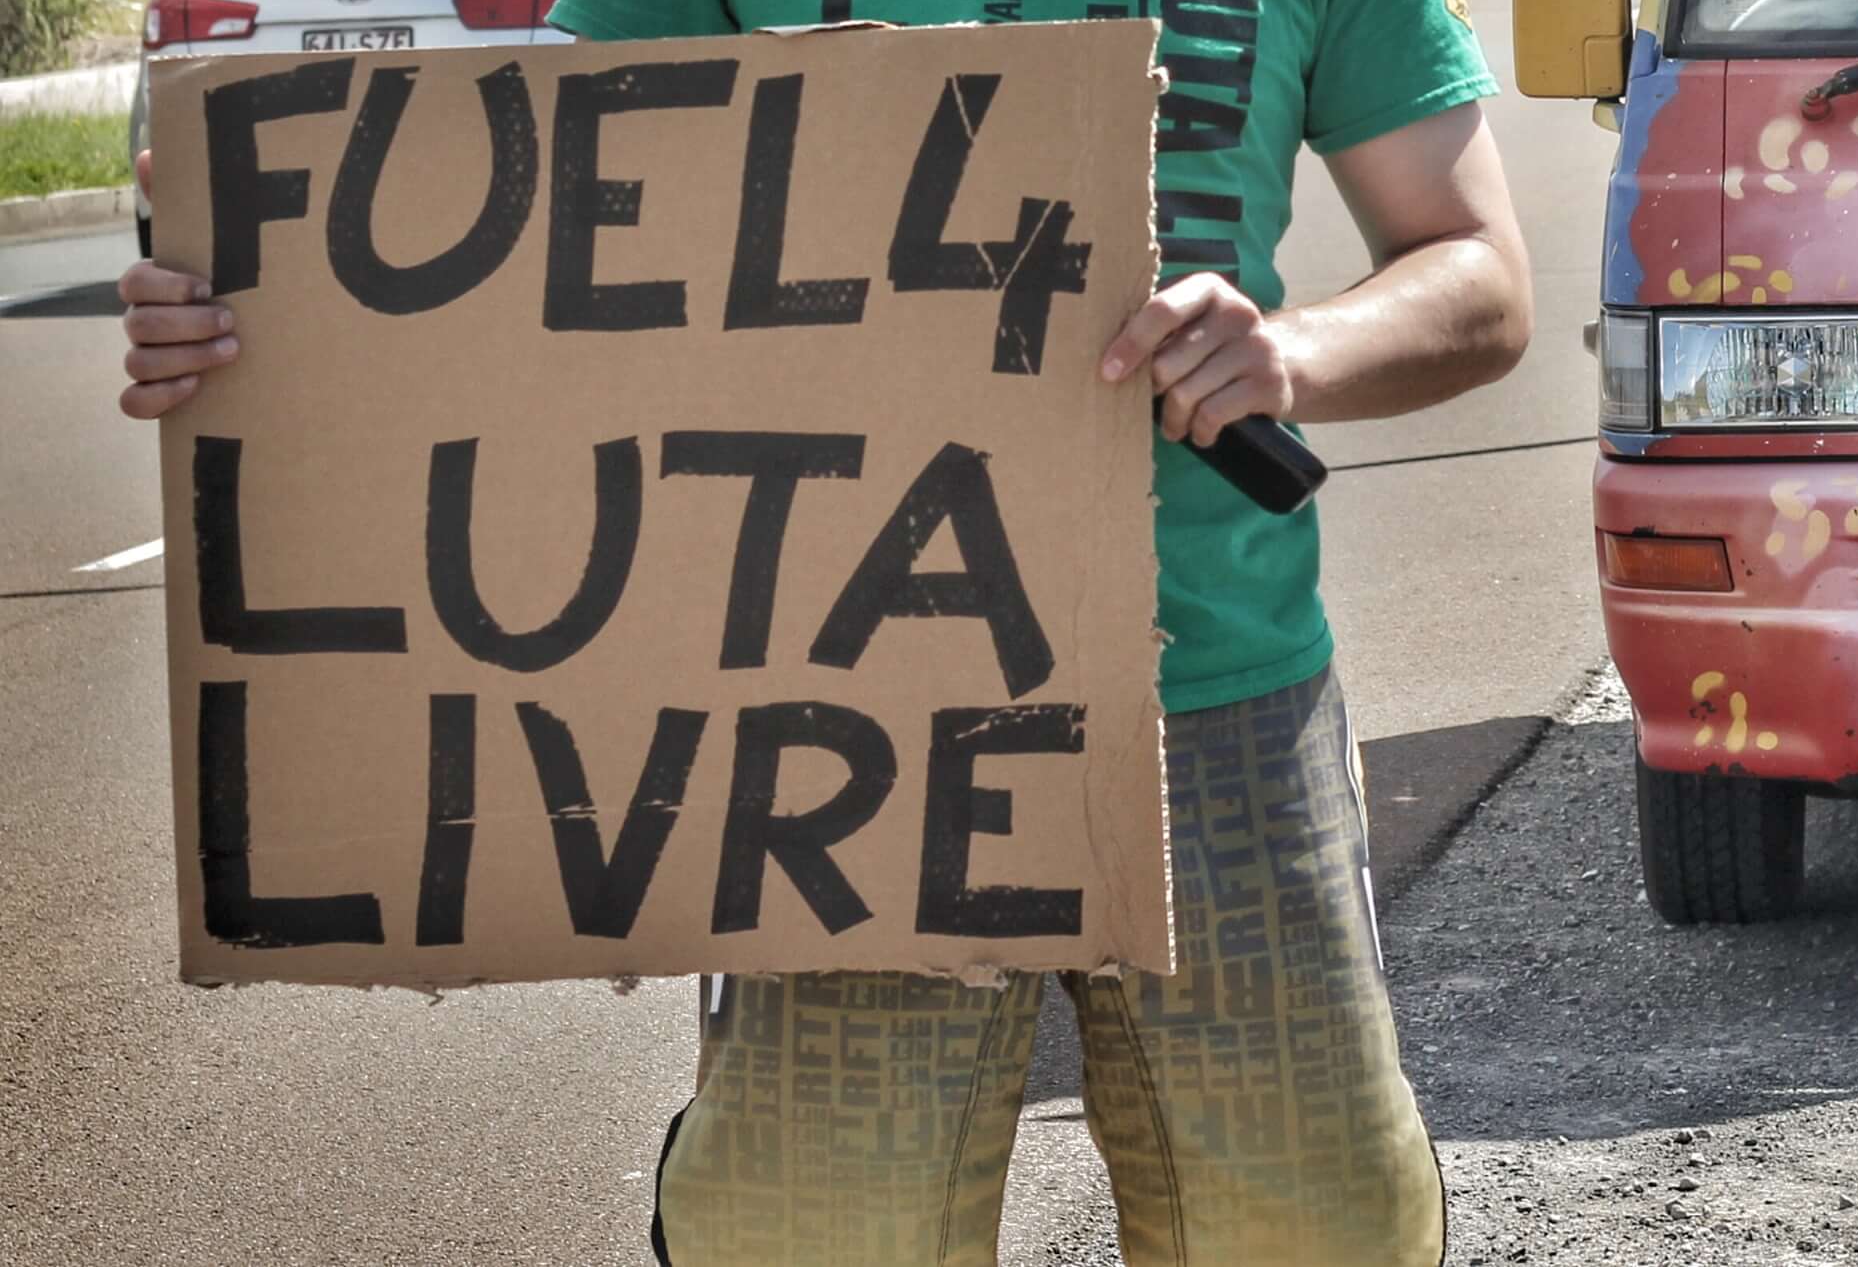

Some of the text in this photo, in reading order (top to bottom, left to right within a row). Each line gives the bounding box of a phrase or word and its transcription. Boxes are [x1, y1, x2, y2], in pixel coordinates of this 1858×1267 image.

[204, 56, 1093, 375] FUEL4
[193, 430, 1057, 700] LUTA
[198, 680, 1088, 948] LIVRE
